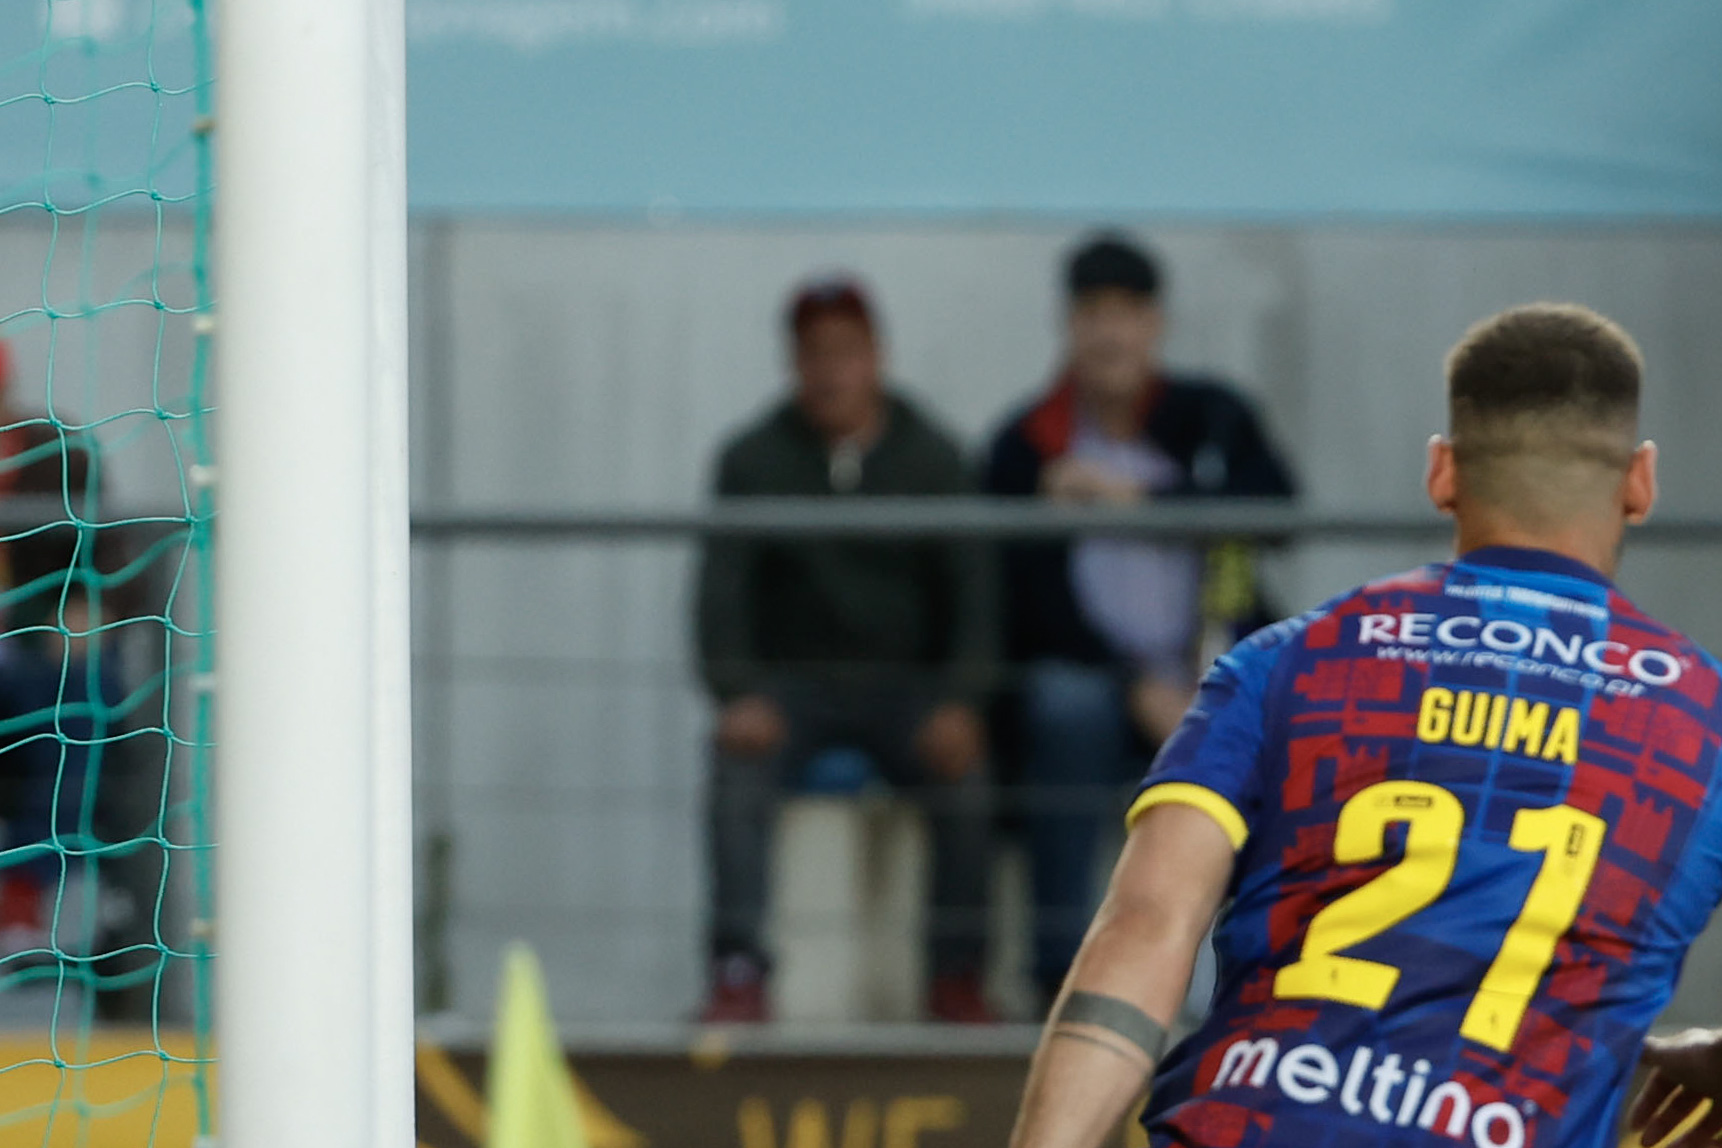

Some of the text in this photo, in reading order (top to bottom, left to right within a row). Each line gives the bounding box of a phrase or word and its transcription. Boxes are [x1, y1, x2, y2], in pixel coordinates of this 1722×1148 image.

[1358, 613, 1681, 686] RECONCO
[1416, 687, 1580, 765] GUIMA
[1272, 779, 1607, 1053] 21
